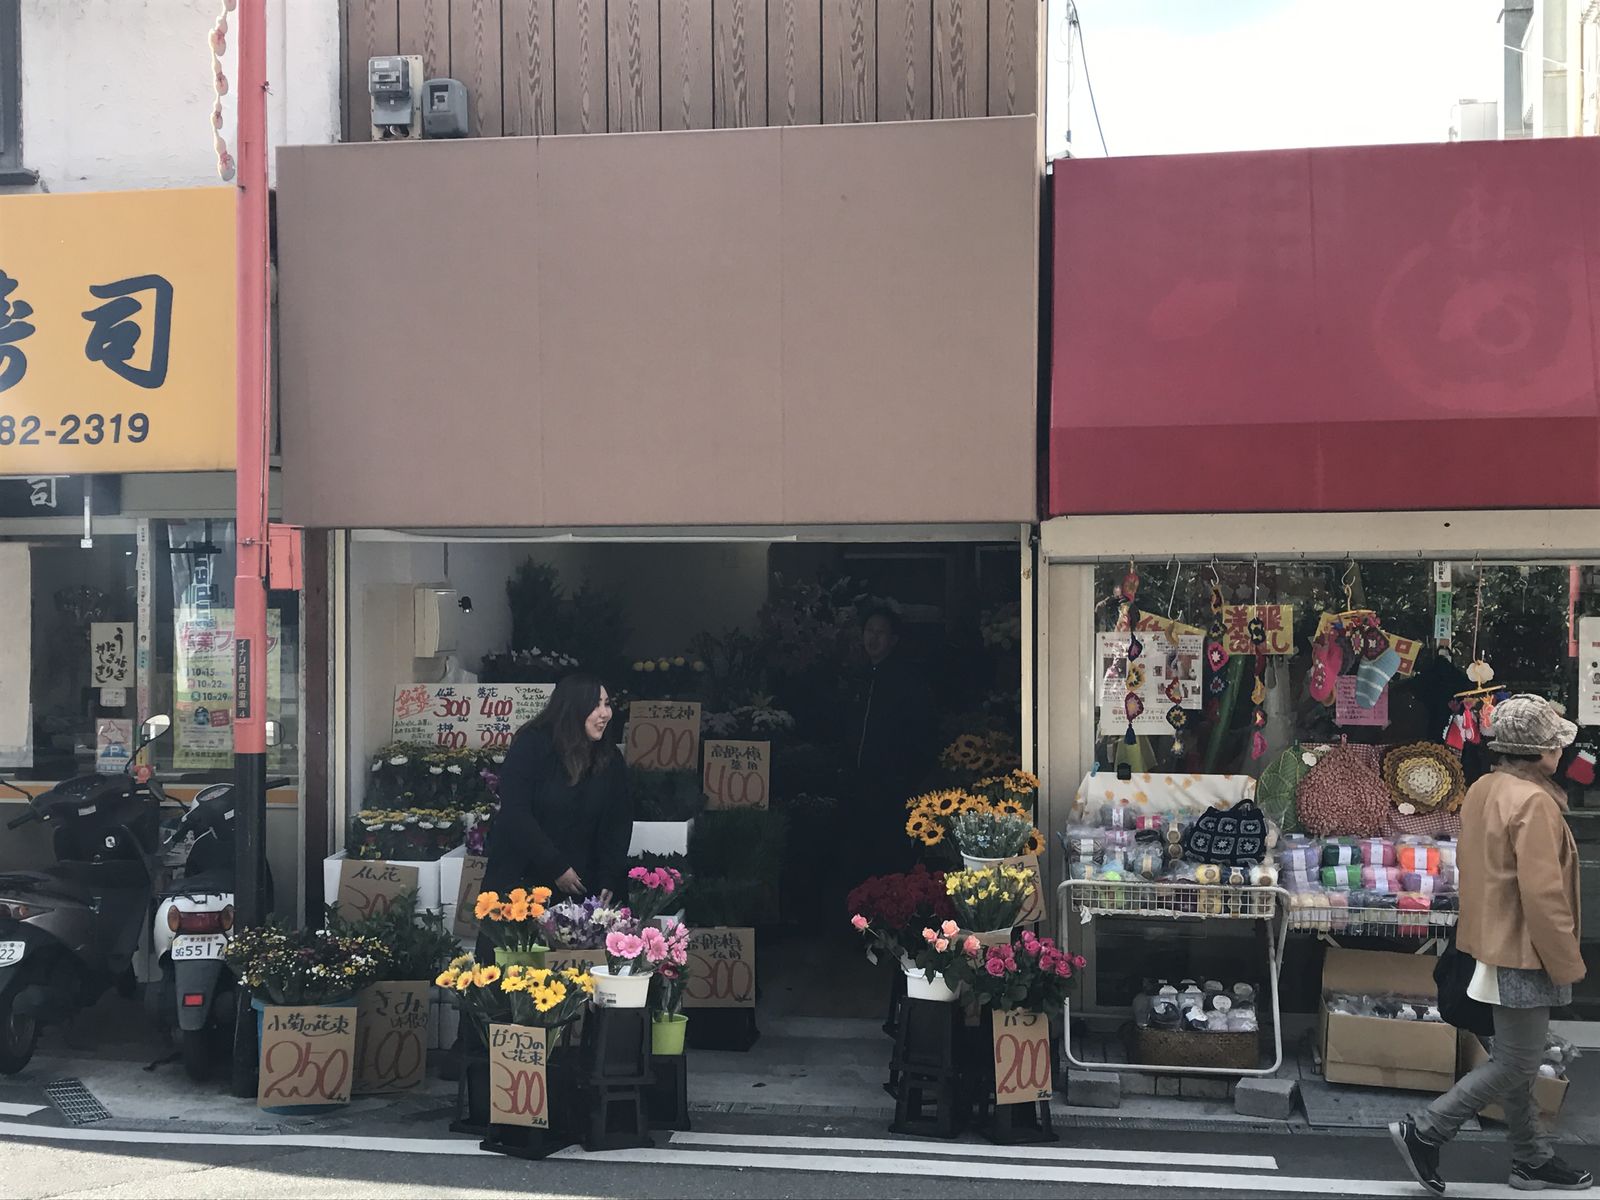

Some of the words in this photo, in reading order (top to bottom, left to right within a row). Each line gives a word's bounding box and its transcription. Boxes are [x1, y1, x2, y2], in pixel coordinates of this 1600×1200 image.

[433, 697, 471, 717] 300
[480, 697, 513, 718] 400
[631, 722, 695, 768] 200
[704, 762, 765, 806] 400
[687, 953, 754, 999] 300
[263, 1040, 349, 1099] 250
[996, 1034, 1051, 1094] 200
[491, 1061, 545, 1116] 300
